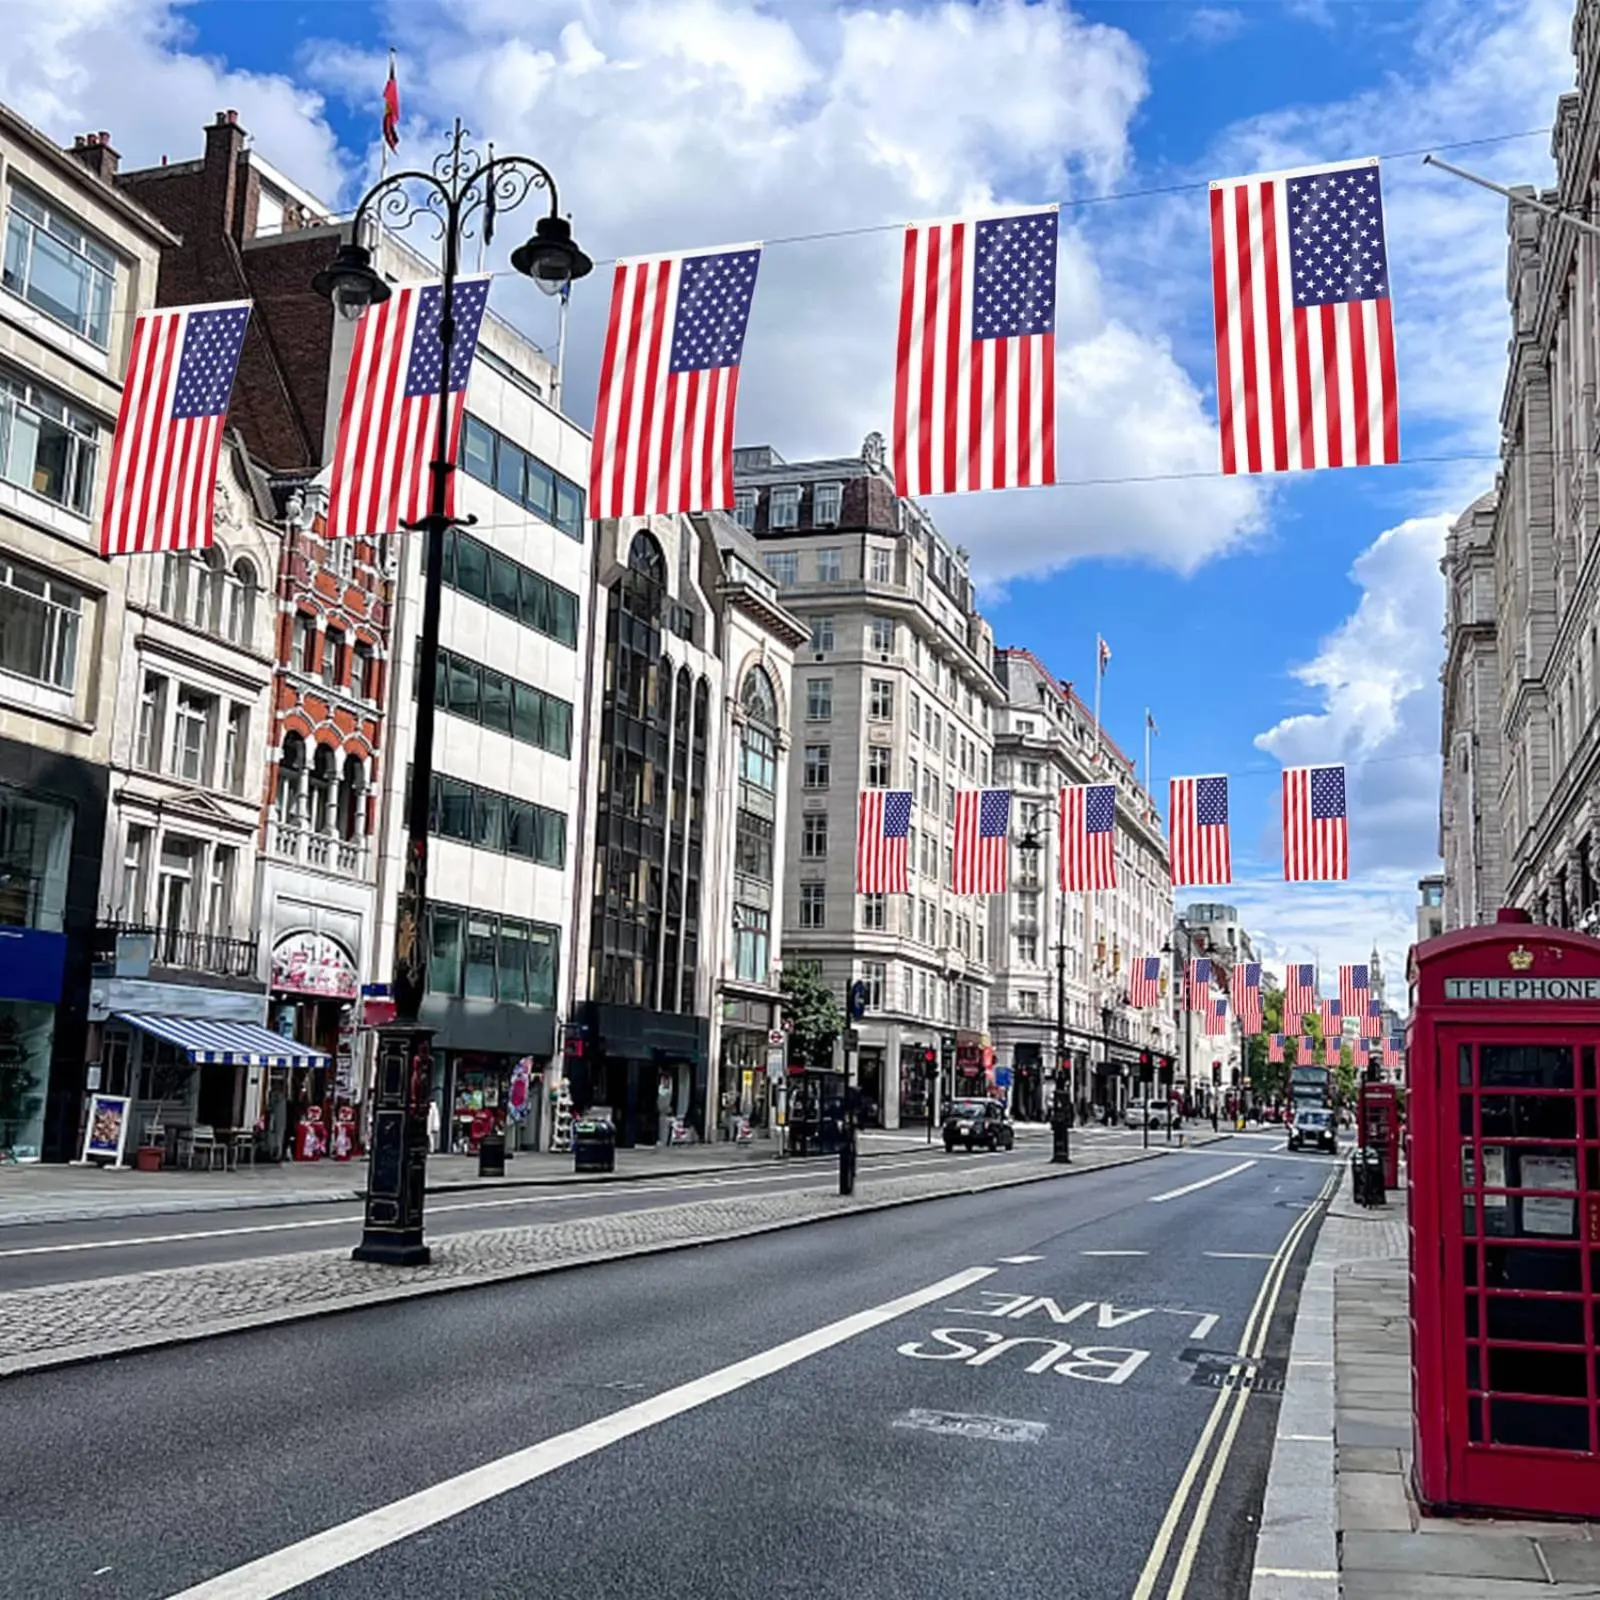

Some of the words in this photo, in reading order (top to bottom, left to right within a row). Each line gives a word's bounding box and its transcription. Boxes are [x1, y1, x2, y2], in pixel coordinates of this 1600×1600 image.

[1451, 979, 1597, 999] TELEPHONE
[944, 1291, 1221, 1340] LANE
[897, 1327, 1151, 1385] BUS
